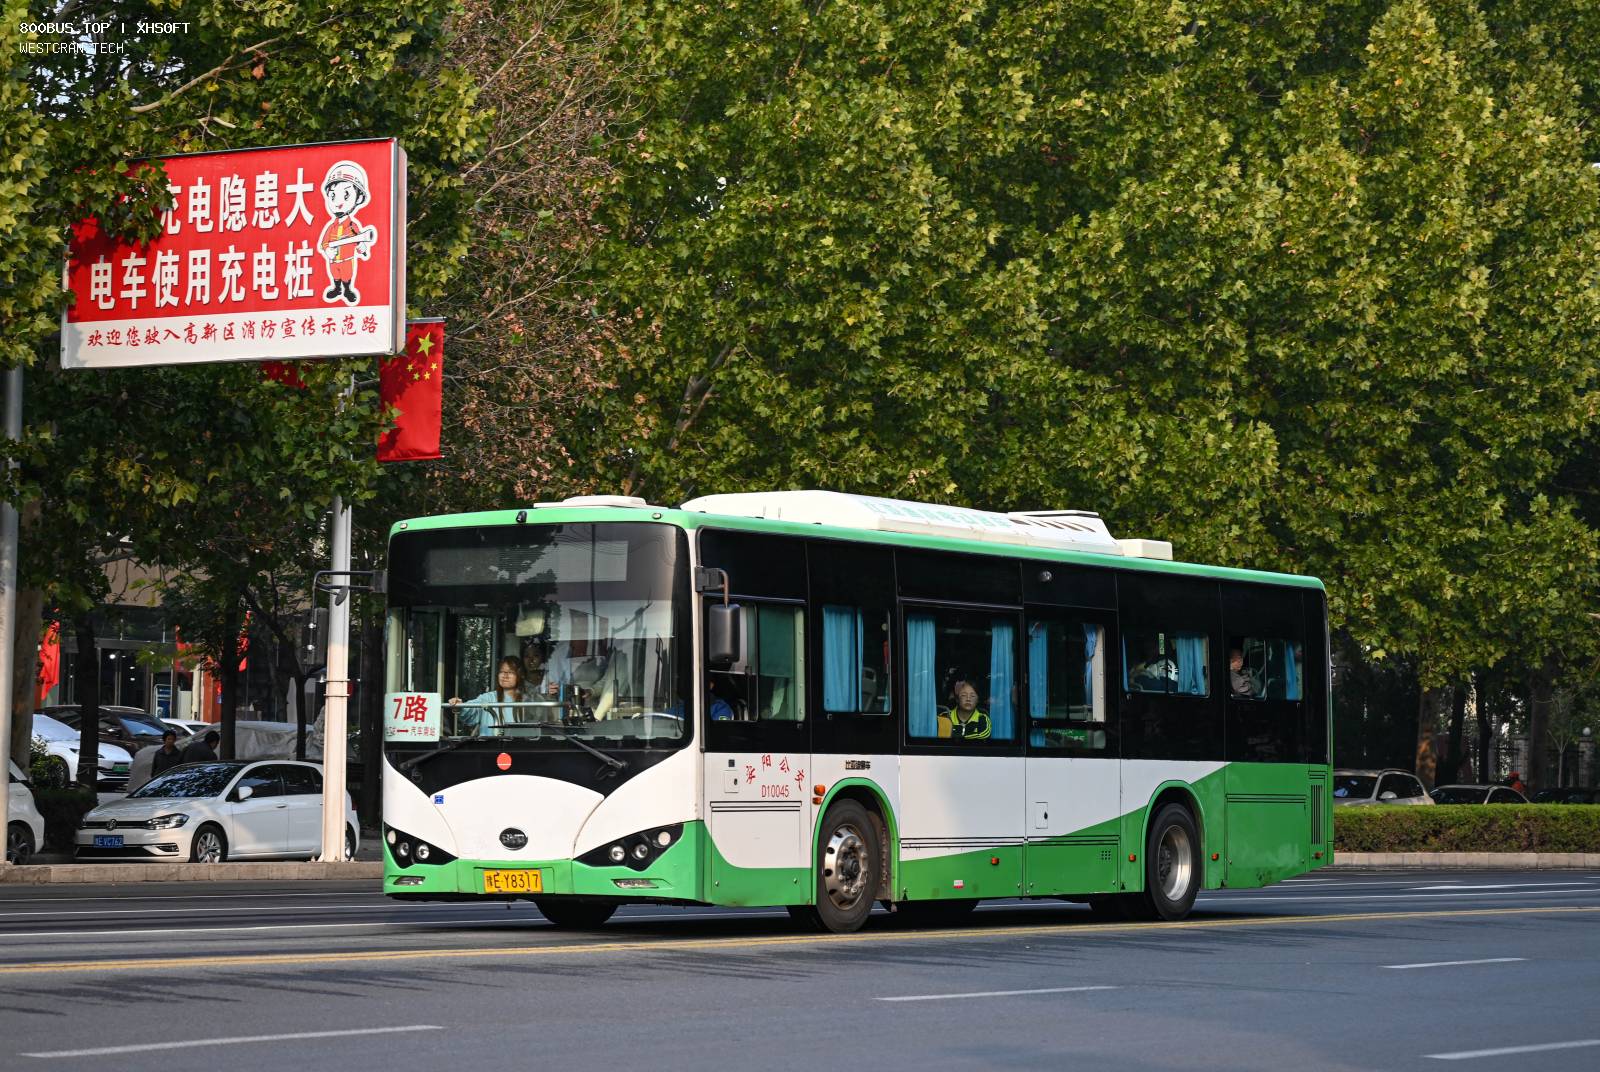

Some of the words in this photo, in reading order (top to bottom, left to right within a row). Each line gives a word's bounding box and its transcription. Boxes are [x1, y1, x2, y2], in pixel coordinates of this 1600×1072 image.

[90, 240, 314, 310] 电车使用充电桩
[87, 313, 379, 348] 欢迎您驶入高新区消防宣传示范路
[393, 695, 428, 722] 7路
[761, 784, 790, 799] D10045
